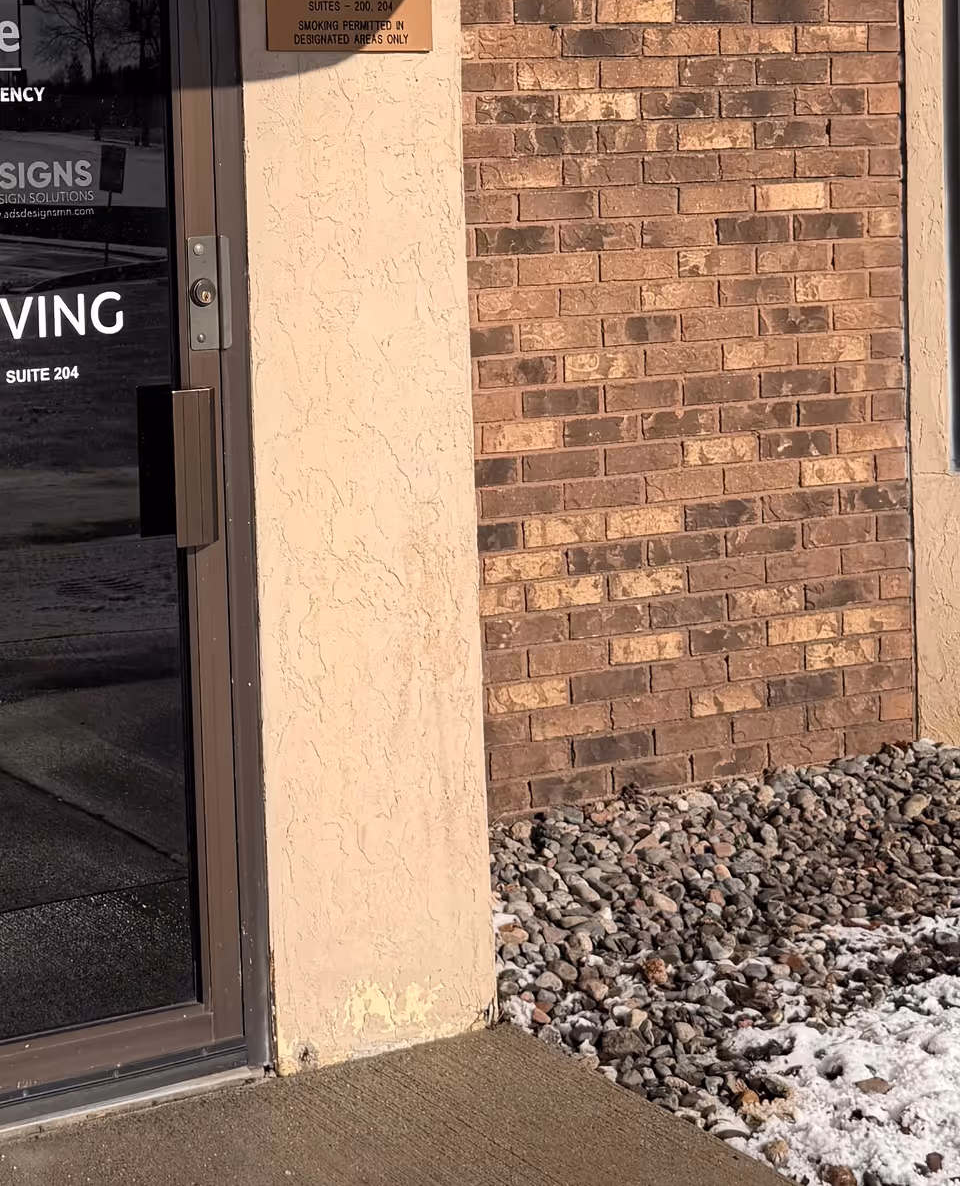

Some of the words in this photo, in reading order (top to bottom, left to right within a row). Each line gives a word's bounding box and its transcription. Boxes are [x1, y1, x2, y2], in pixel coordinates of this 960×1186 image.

[308, 0, 341, 11] SUITES
[377, 0, 393, 12] 204
[298, 20, 339, 31] SMOKING
[342, 20, 392, 31] PERMITTED
[395, 20, 405, 31] IN
[294, 34, 350, 45] DESIGNATED
[353, 34, 383, 45] AREAS
[386, 34, 409, 45] ONLY
[29, 190, 95, 203] SOLUTIONS
[6, 369, 50, 384] SUITE
[53, 365, 79, 381] 204
